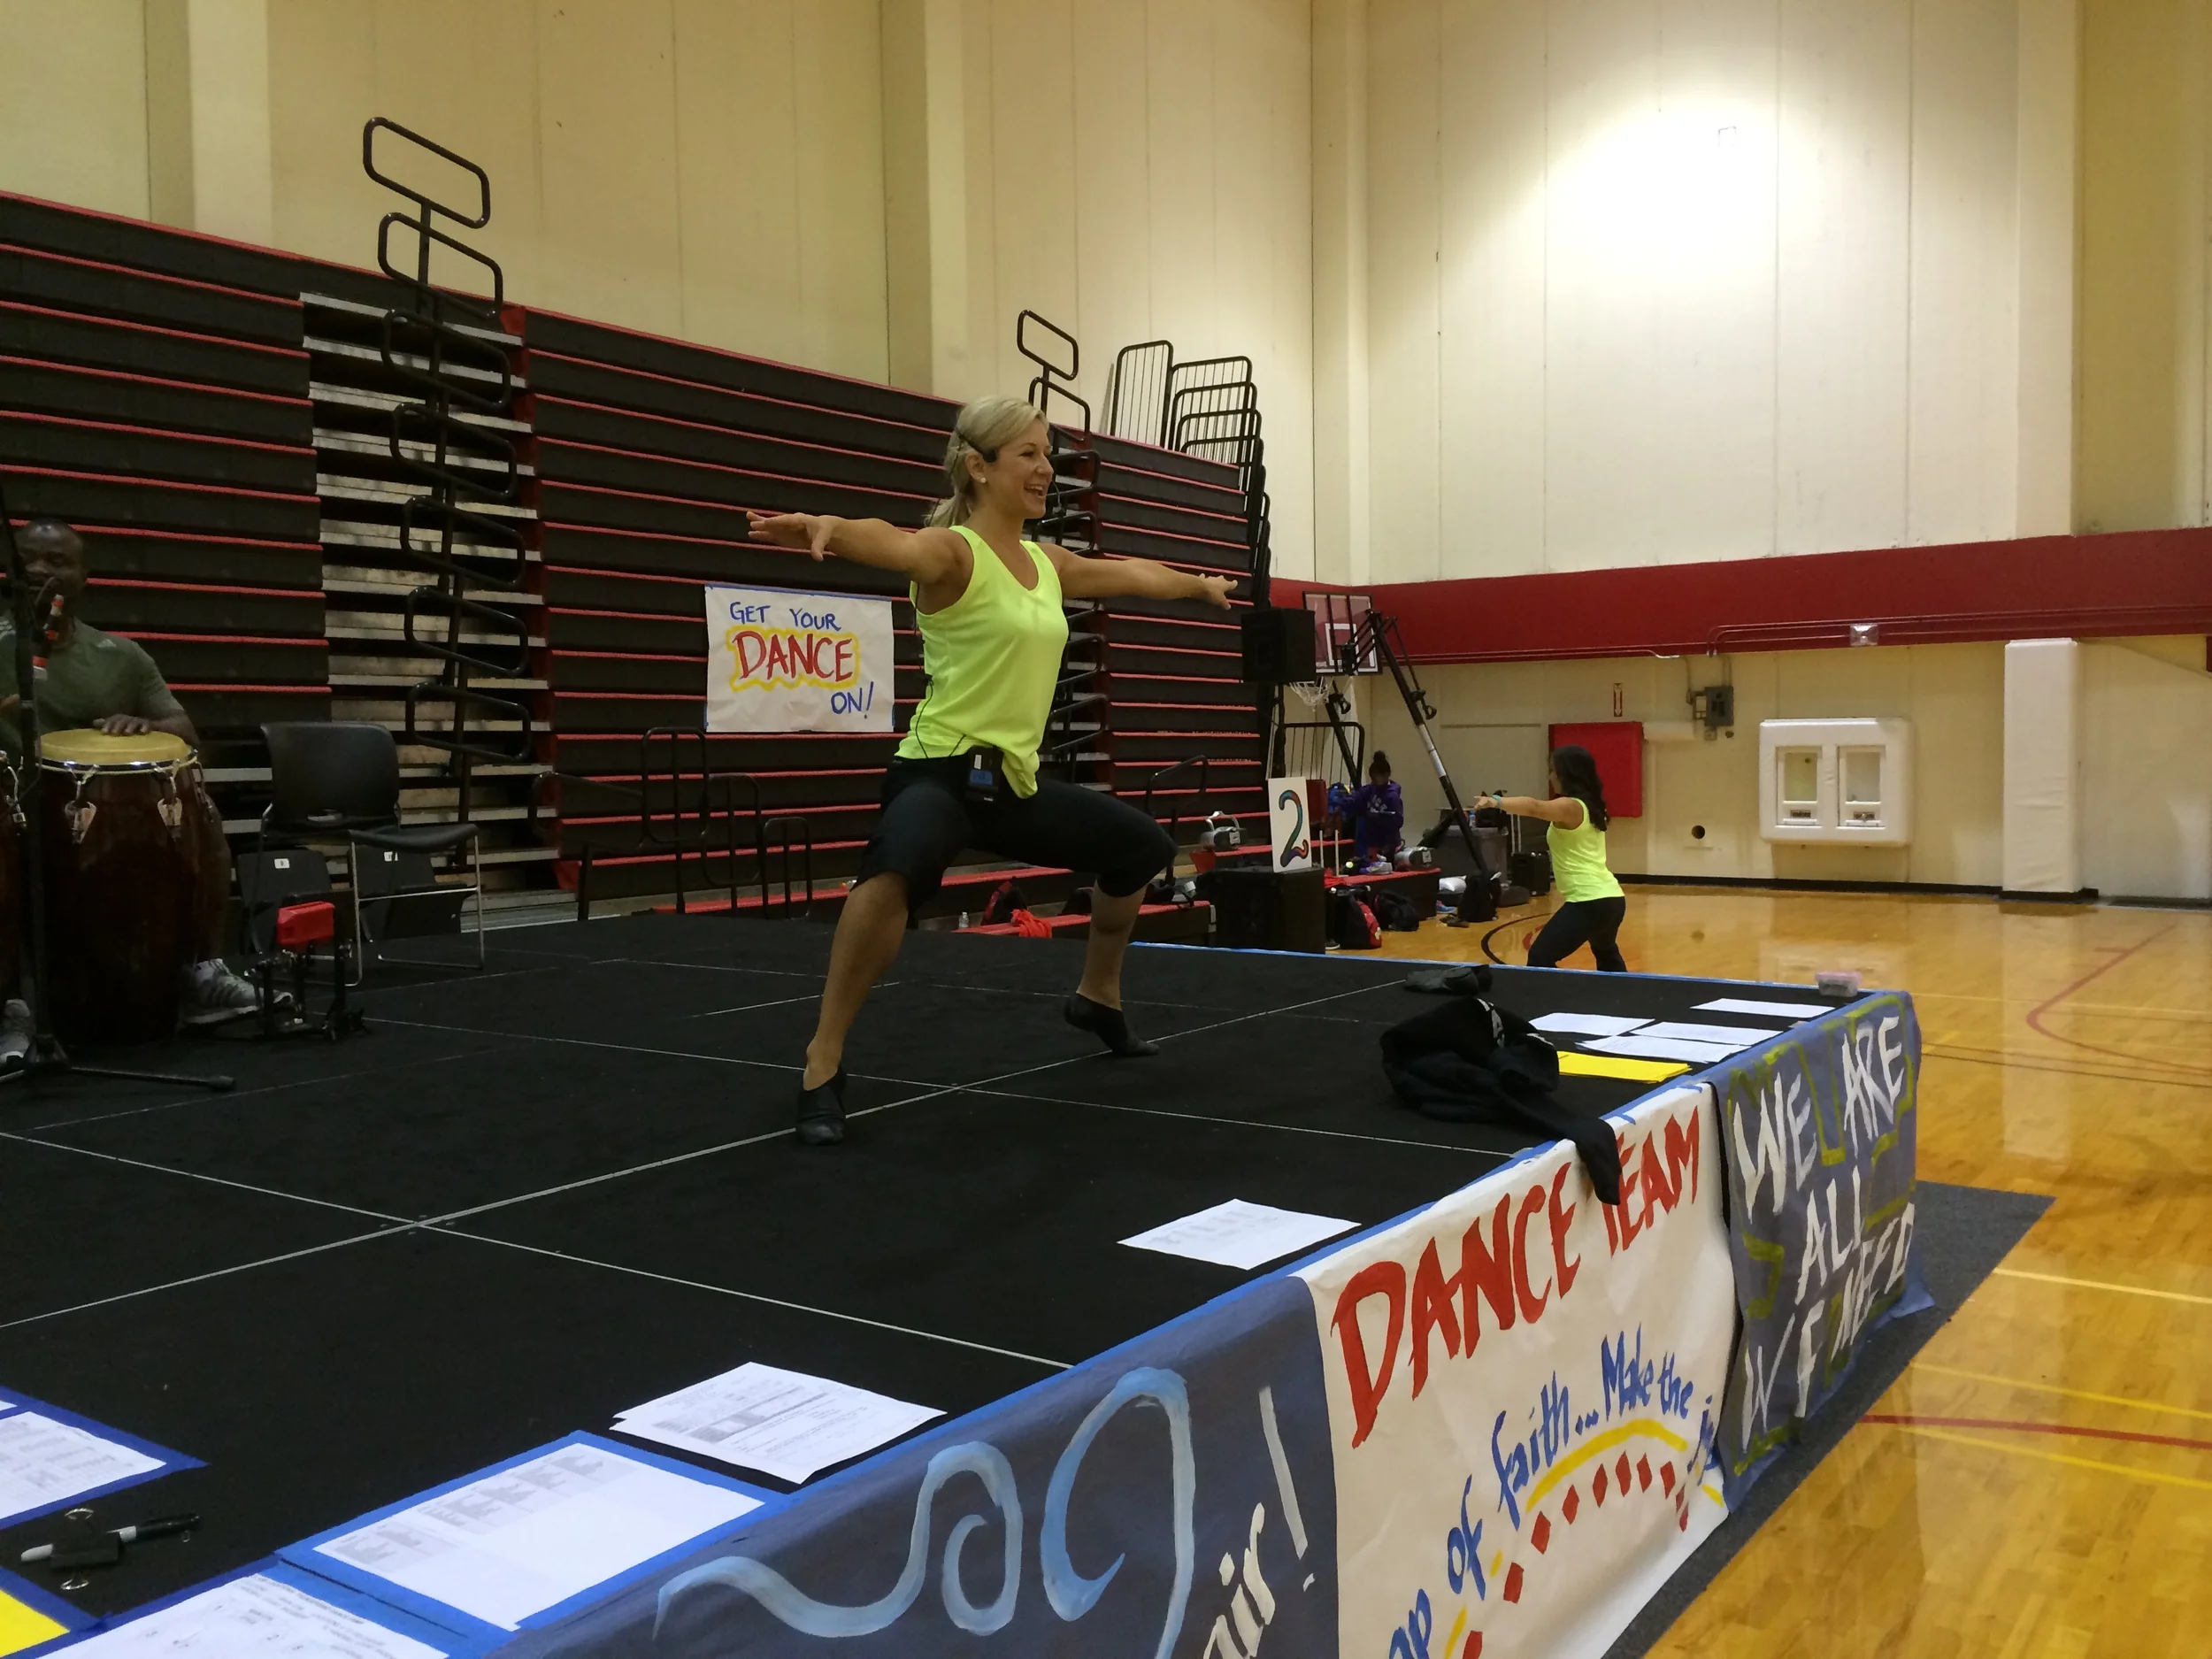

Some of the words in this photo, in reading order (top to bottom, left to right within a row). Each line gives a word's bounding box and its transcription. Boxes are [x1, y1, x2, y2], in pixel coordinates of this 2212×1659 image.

[730, 602, 771, 625] GET
[789, 608, 841, 632] YOUR
[732, 631, 852, 682] DANCE
[831, 681, 874, 719] ON!
[1279, 790, 1309, 867] 2
[1733, 1072, 1816, 1223] WE
[1842, 1016, 1904, 1157] ARE
[1795, 1165, 1865, 1306] ALL
[1331, 1162, 1581, 1449] DANCE
[1448, 1474, 1486, 1601] of
[1601, 1321, 1655, 1423] Make
[1657, 1351, 1694, 1420] the
